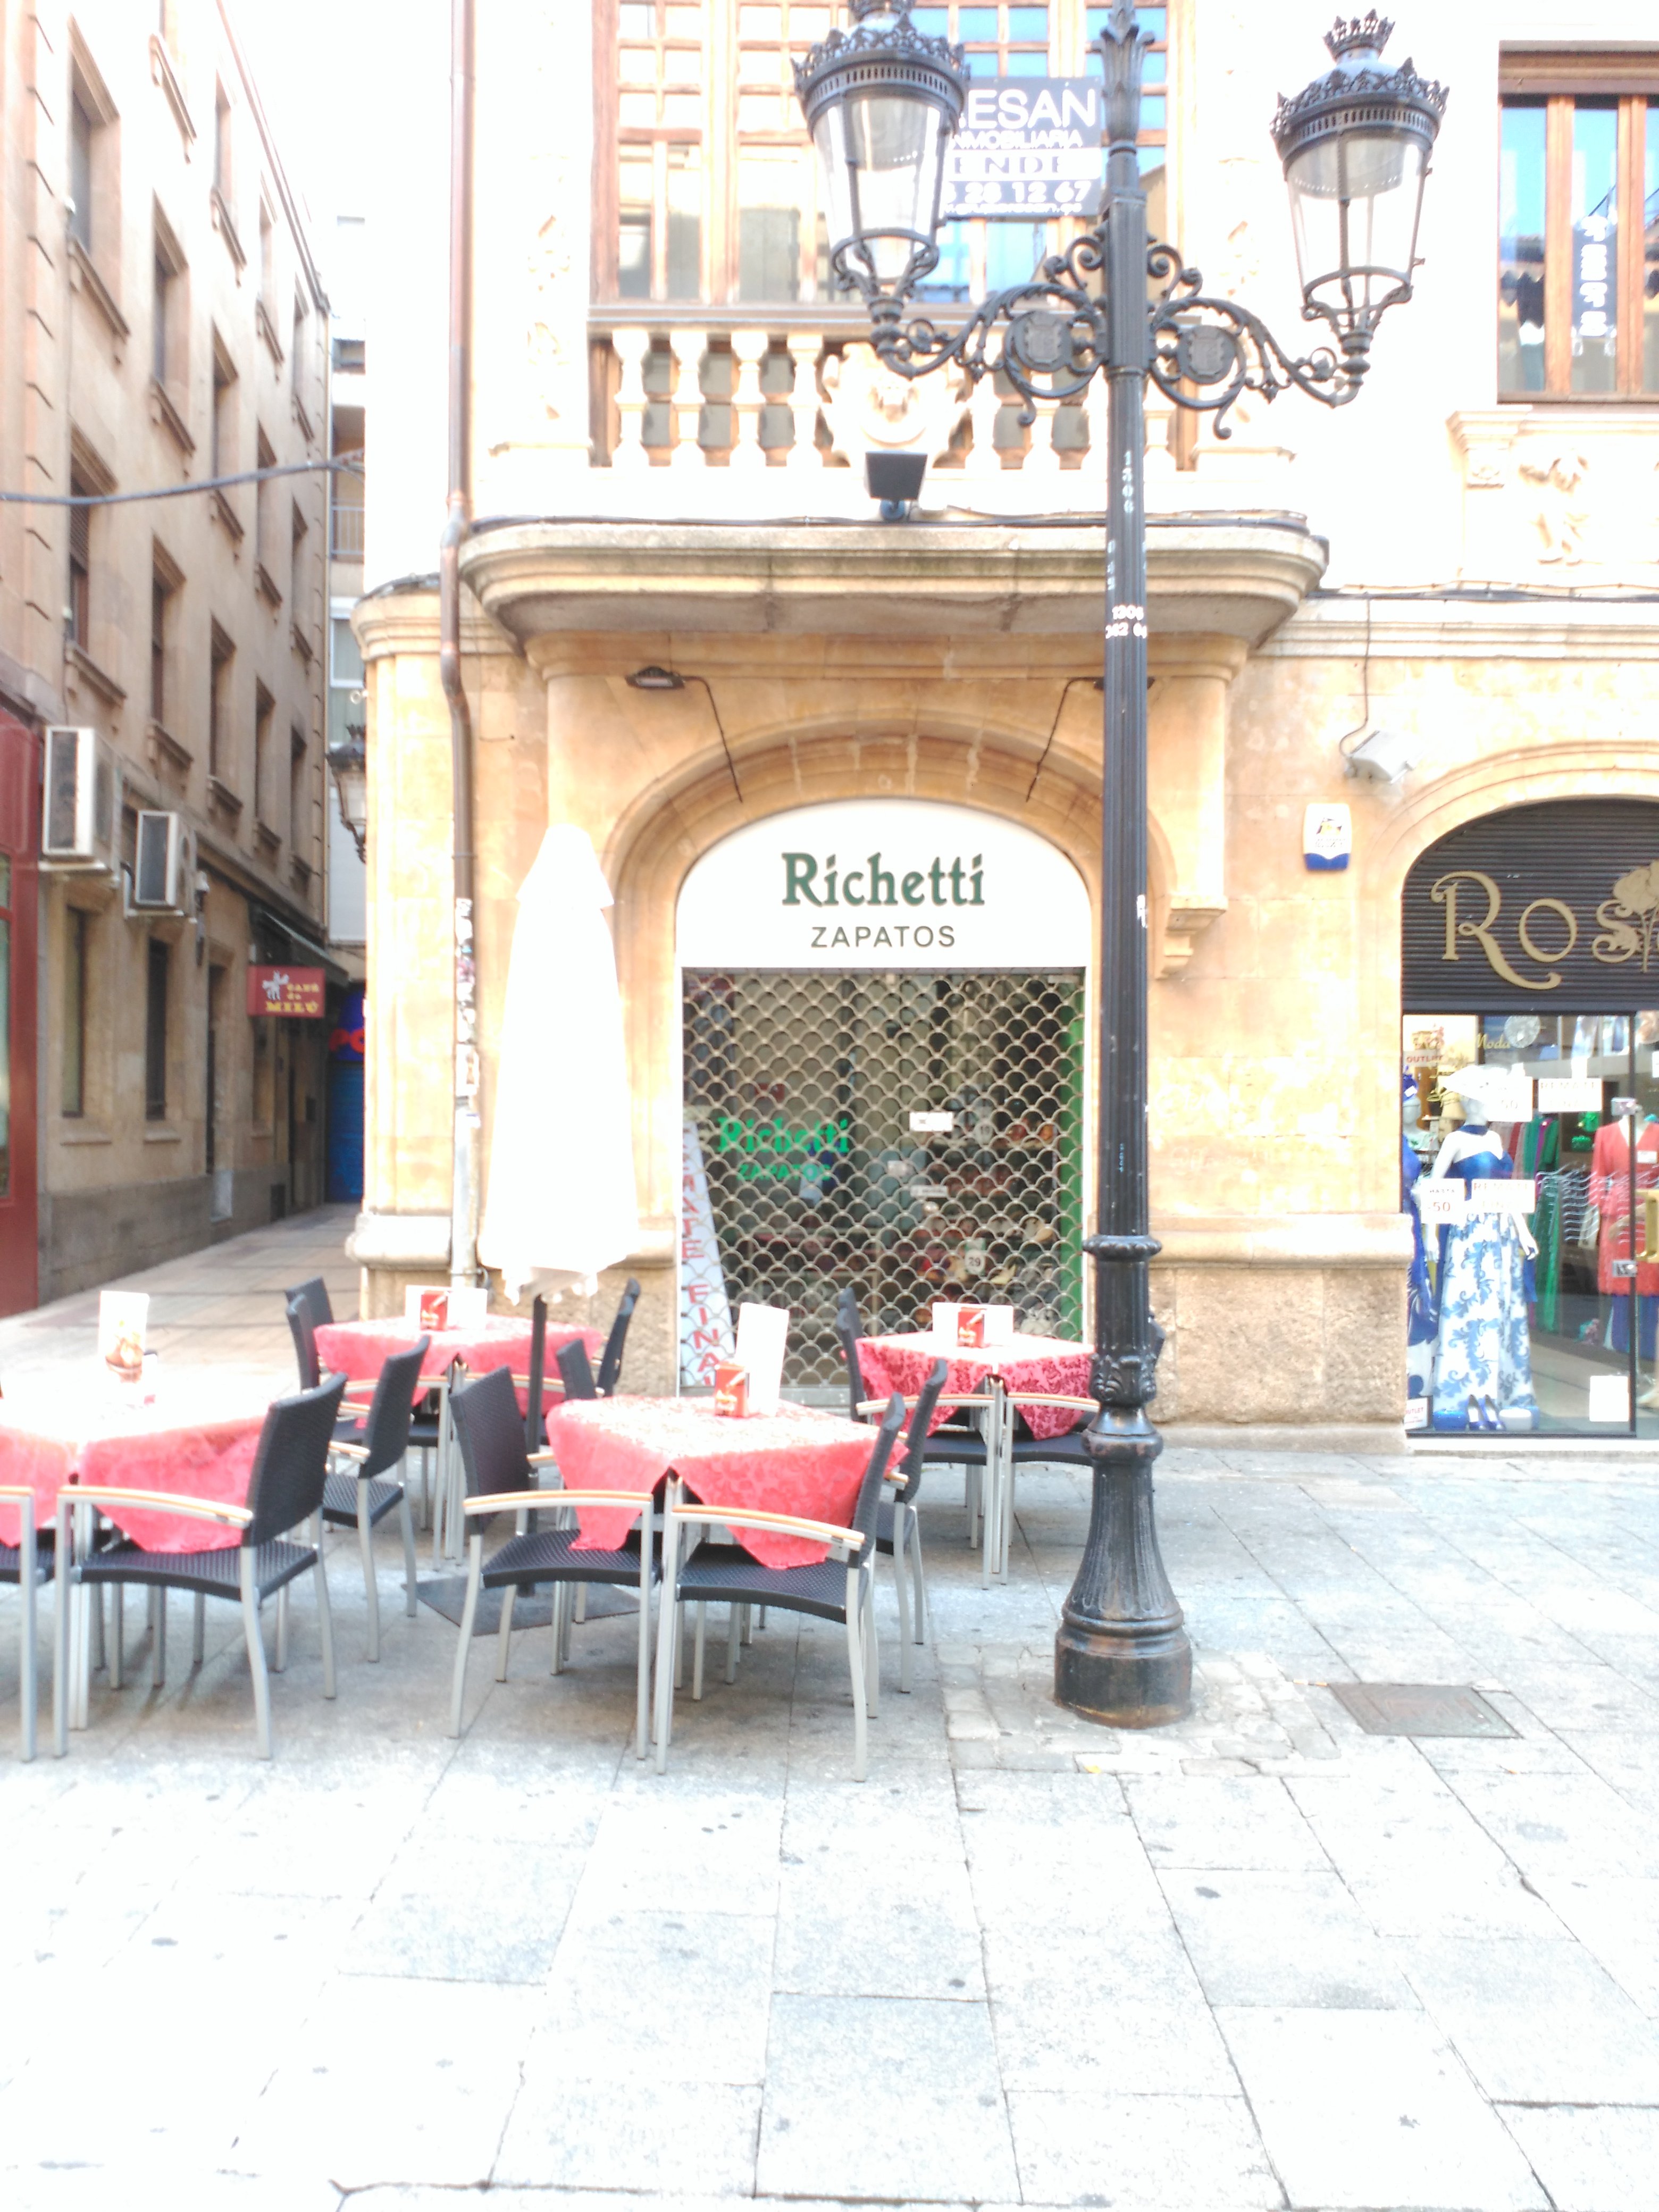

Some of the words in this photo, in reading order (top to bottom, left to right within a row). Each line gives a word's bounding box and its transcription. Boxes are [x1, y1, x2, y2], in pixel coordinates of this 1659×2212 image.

[959, 88, 1096, 129] ESAN
[1011, 181, 1046, 203] 12
[1054, 181, 1092, 203] 67
[781, 852, 985, 907] Richetti
[811, 925, 956, 948] ZAPATOS
[717, 1117, 849, 1153] Richetti
[737, 1163, 831, 1180] ZAPATOS
